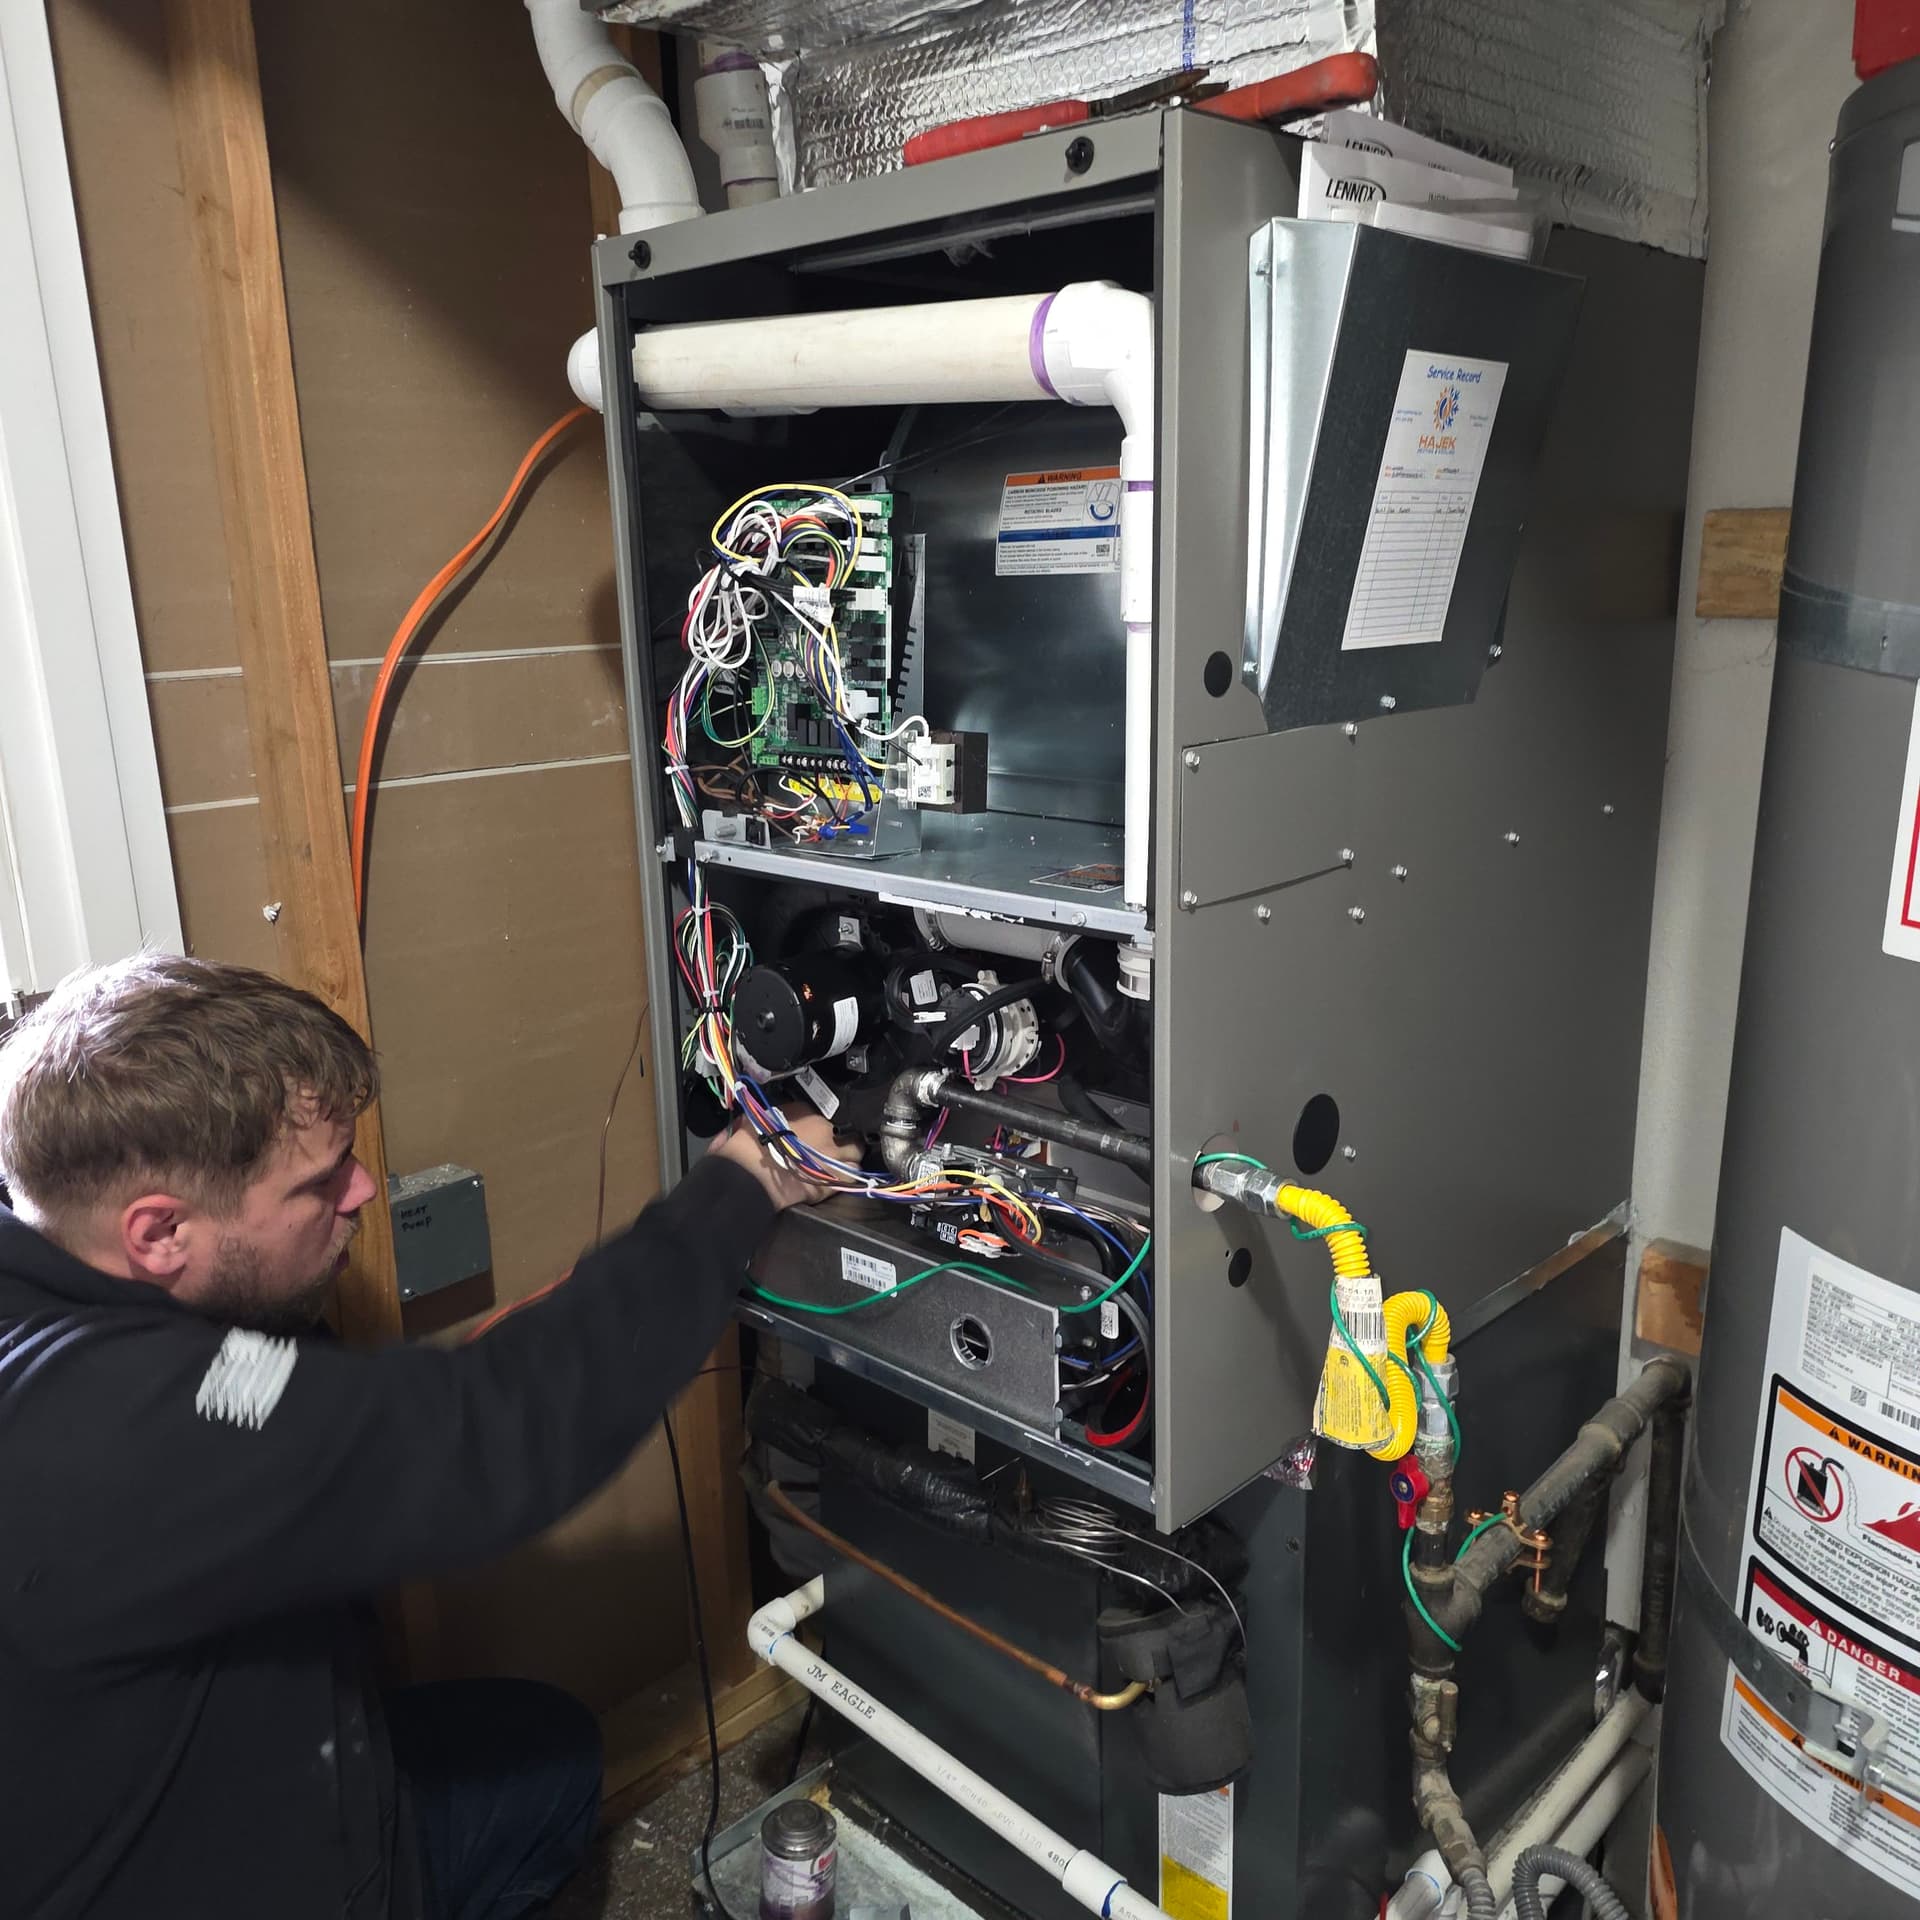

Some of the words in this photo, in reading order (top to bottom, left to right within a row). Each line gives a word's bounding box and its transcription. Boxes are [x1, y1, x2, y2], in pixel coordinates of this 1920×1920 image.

[1325, 178, 1376, 203] LENNOX
[1427, 364, 1455, 380] Service
[1457, 368, 1482, 384] Record
[1419, 434, 1456, 449] HAJEK
[1803, 1530, 1818, 1542] Can
[1827, 1537, 1844, 1550] AND
[1844, 1547, 1891, 1578] EXPLOSION
[1862, 1532, 1913, 1566] Flammable
[1826, 1629, 1900, 1682] DANGER
[806, 1664, 828, 1682] JM
[831, 1680, 876, 1719] EAGLE
[1047, 1850, 1067, 1868] 480
